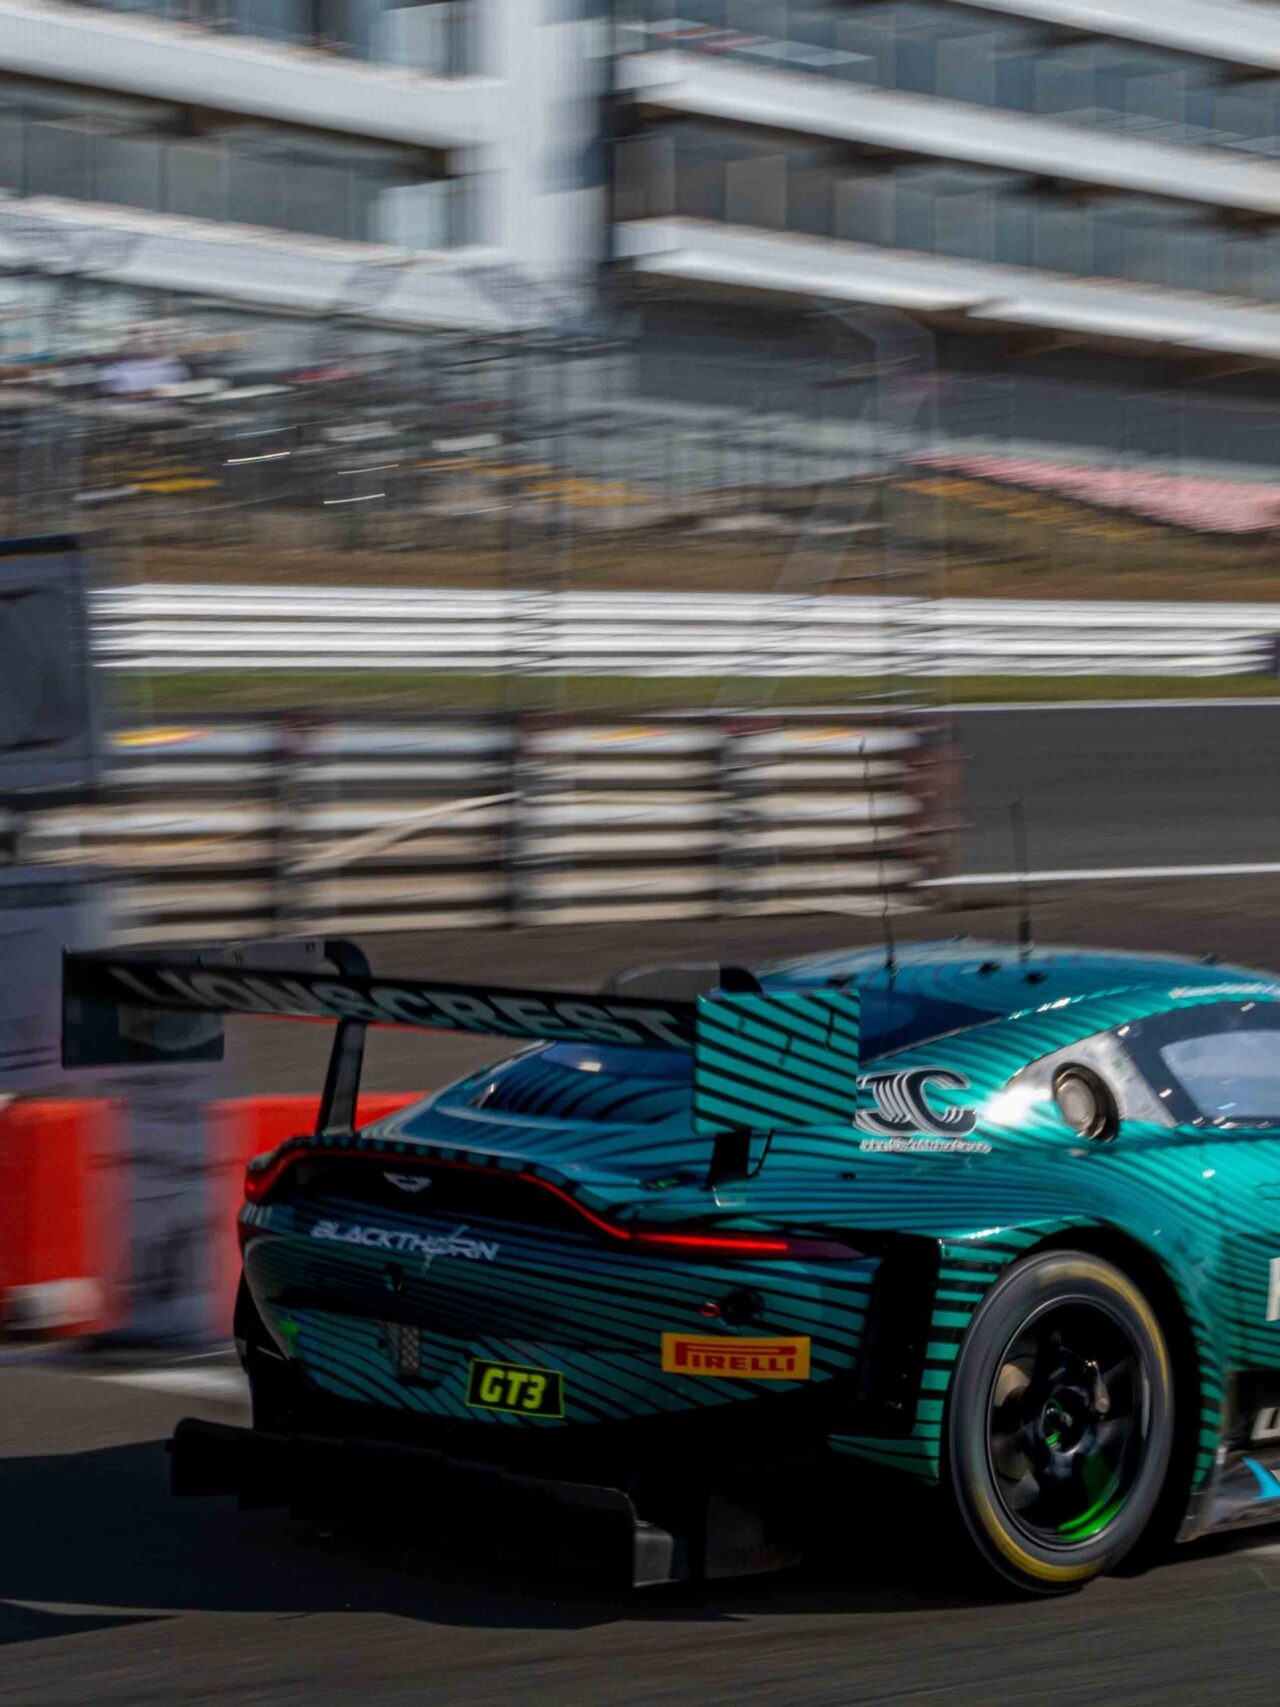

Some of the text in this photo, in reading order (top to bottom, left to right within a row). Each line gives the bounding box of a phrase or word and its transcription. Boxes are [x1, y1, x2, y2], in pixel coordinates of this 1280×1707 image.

[108, 965, 695, 1047] LIONSCREST
[310, 1221, 499, 1263] BLACKTHORN
[674, 1342, 798, 1372] PIRELLI
[479, 1367, 547, 1409] GT3
